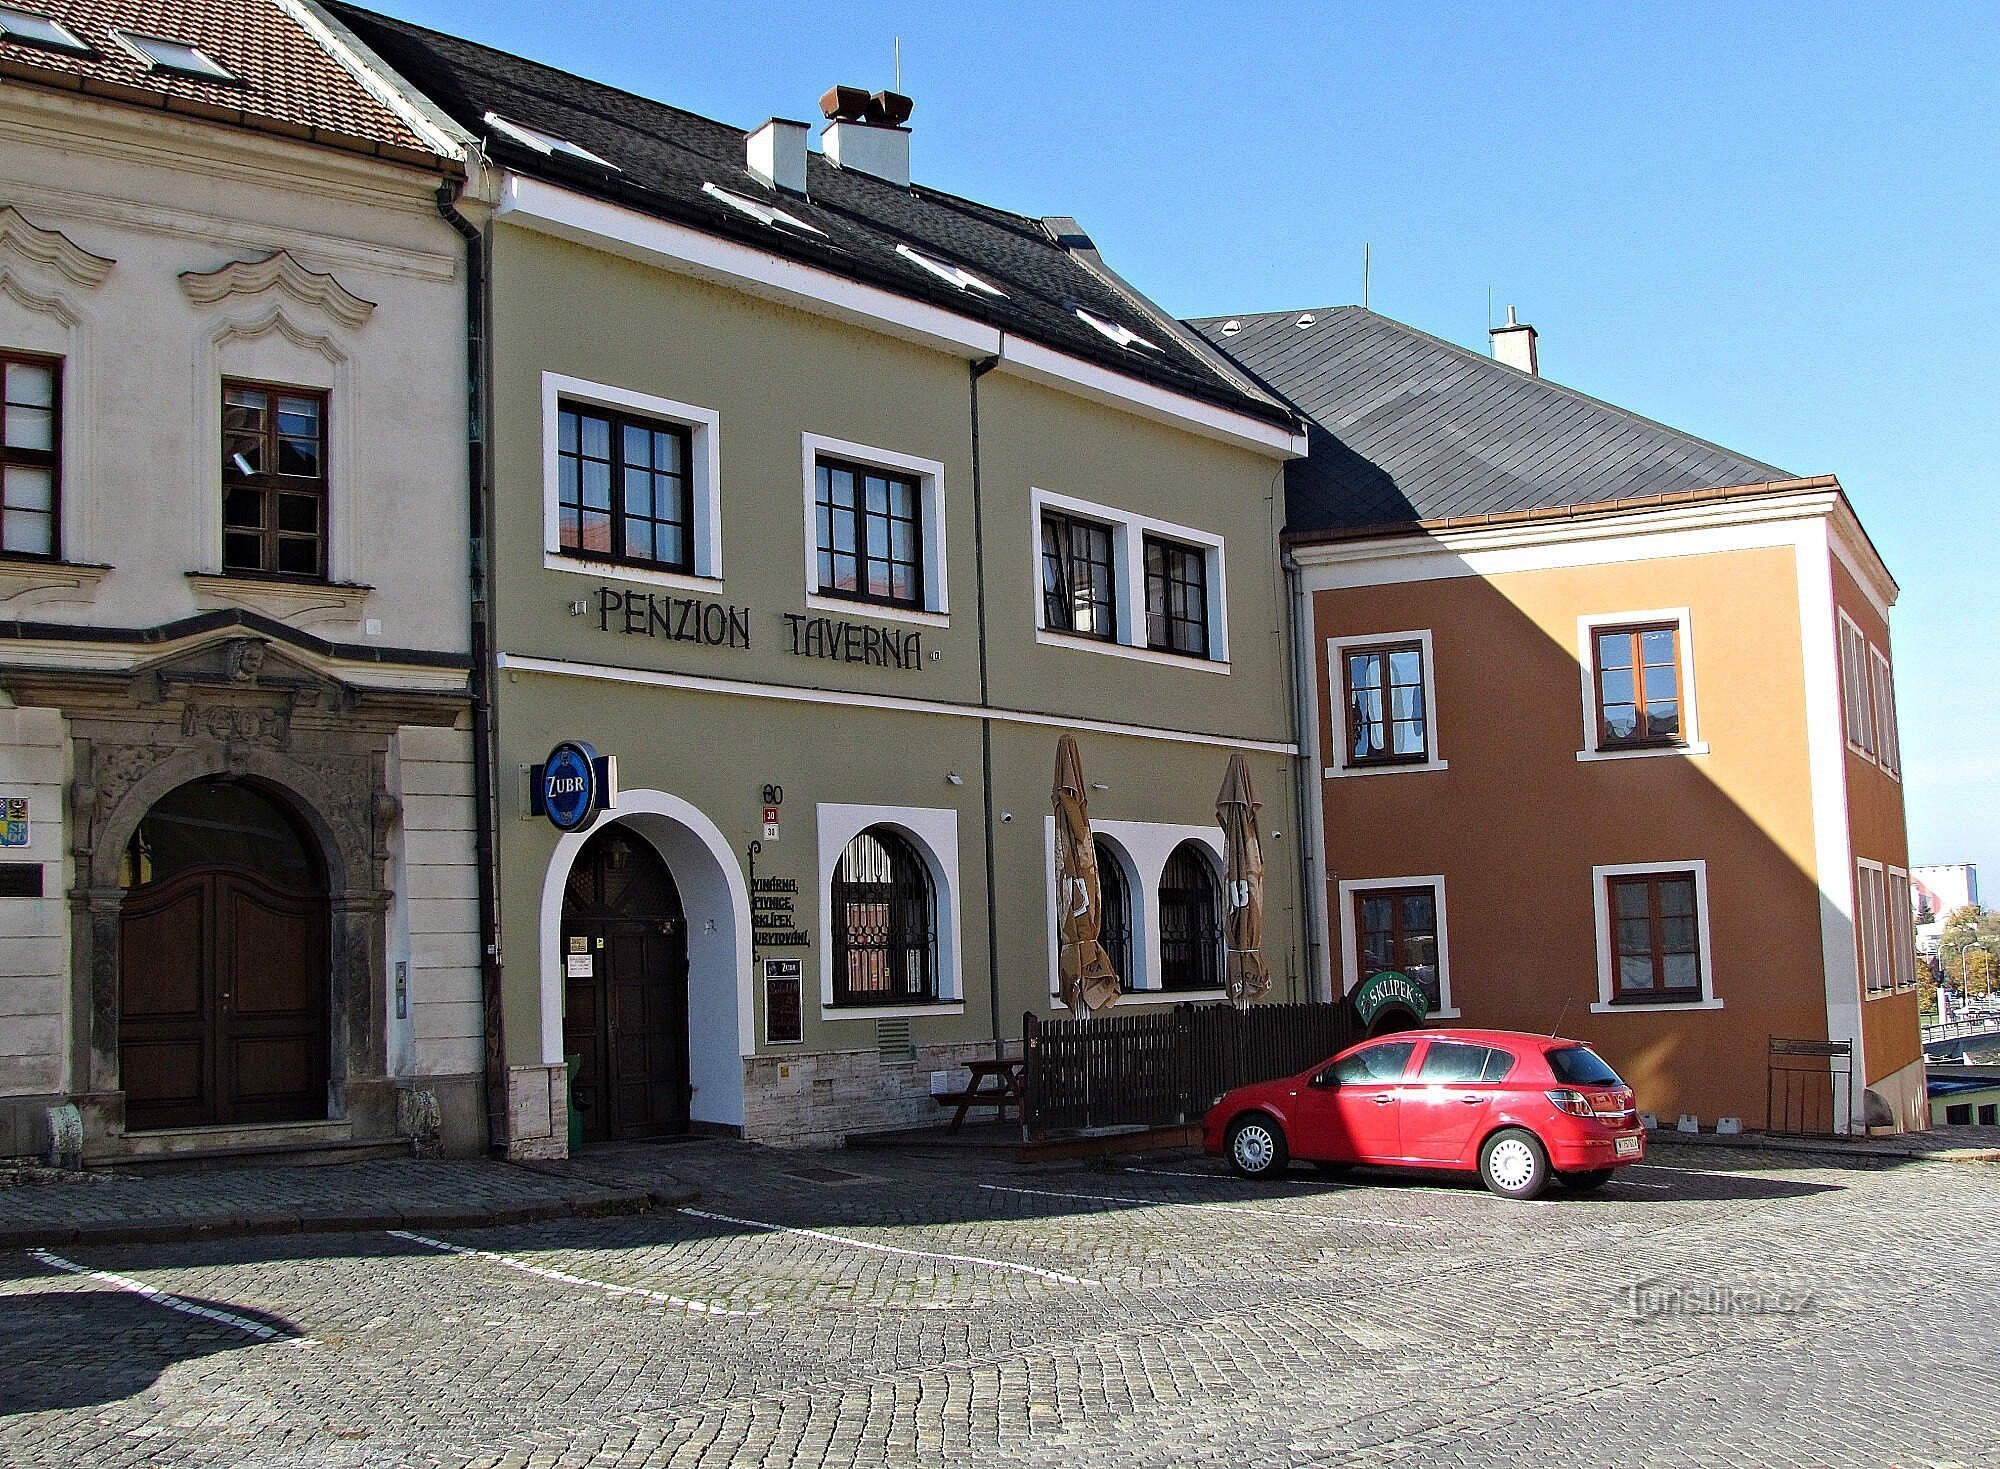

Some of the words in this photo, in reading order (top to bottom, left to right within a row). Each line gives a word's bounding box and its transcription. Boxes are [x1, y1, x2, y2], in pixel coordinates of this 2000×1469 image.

[594, 586, 750, 649] PENZION
[784, 612, 922, 671] TAVERNA
[546, 775, 584, 798] ZUBR
[1369, 974, 1414, 1006] SKLÍPEK
